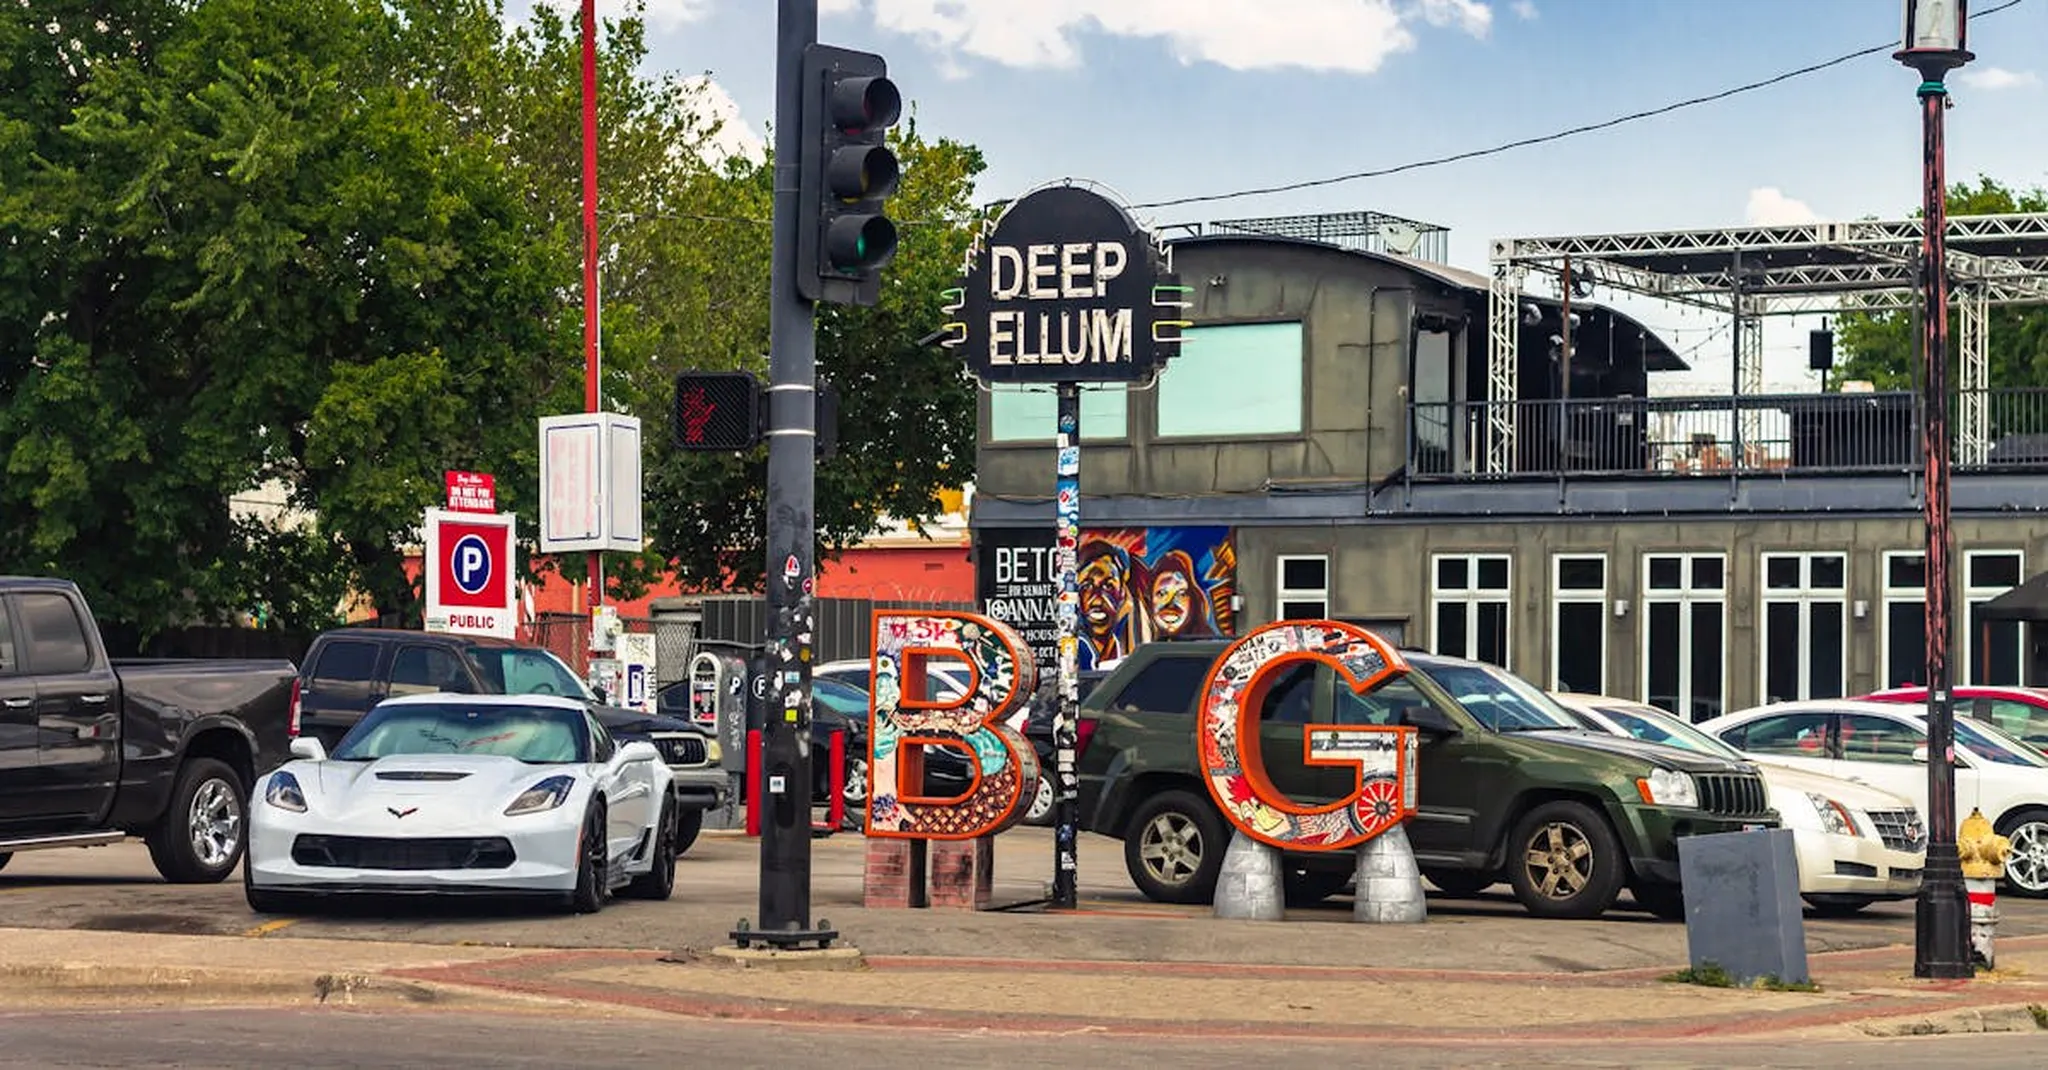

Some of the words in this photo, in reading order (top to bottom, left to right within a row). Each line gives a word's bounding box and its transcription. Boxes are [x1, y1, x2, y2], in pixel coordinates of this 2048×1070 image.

[990, 241, 1128, 300] DEEP
[989, 308, 1133, 365] ELLUM
[462, 546, 483, 583] P
[450, 614, 495, 629] PUBLIC
[865, 609, 1036, 841] B
[1197, 619, 1417, 853] G
